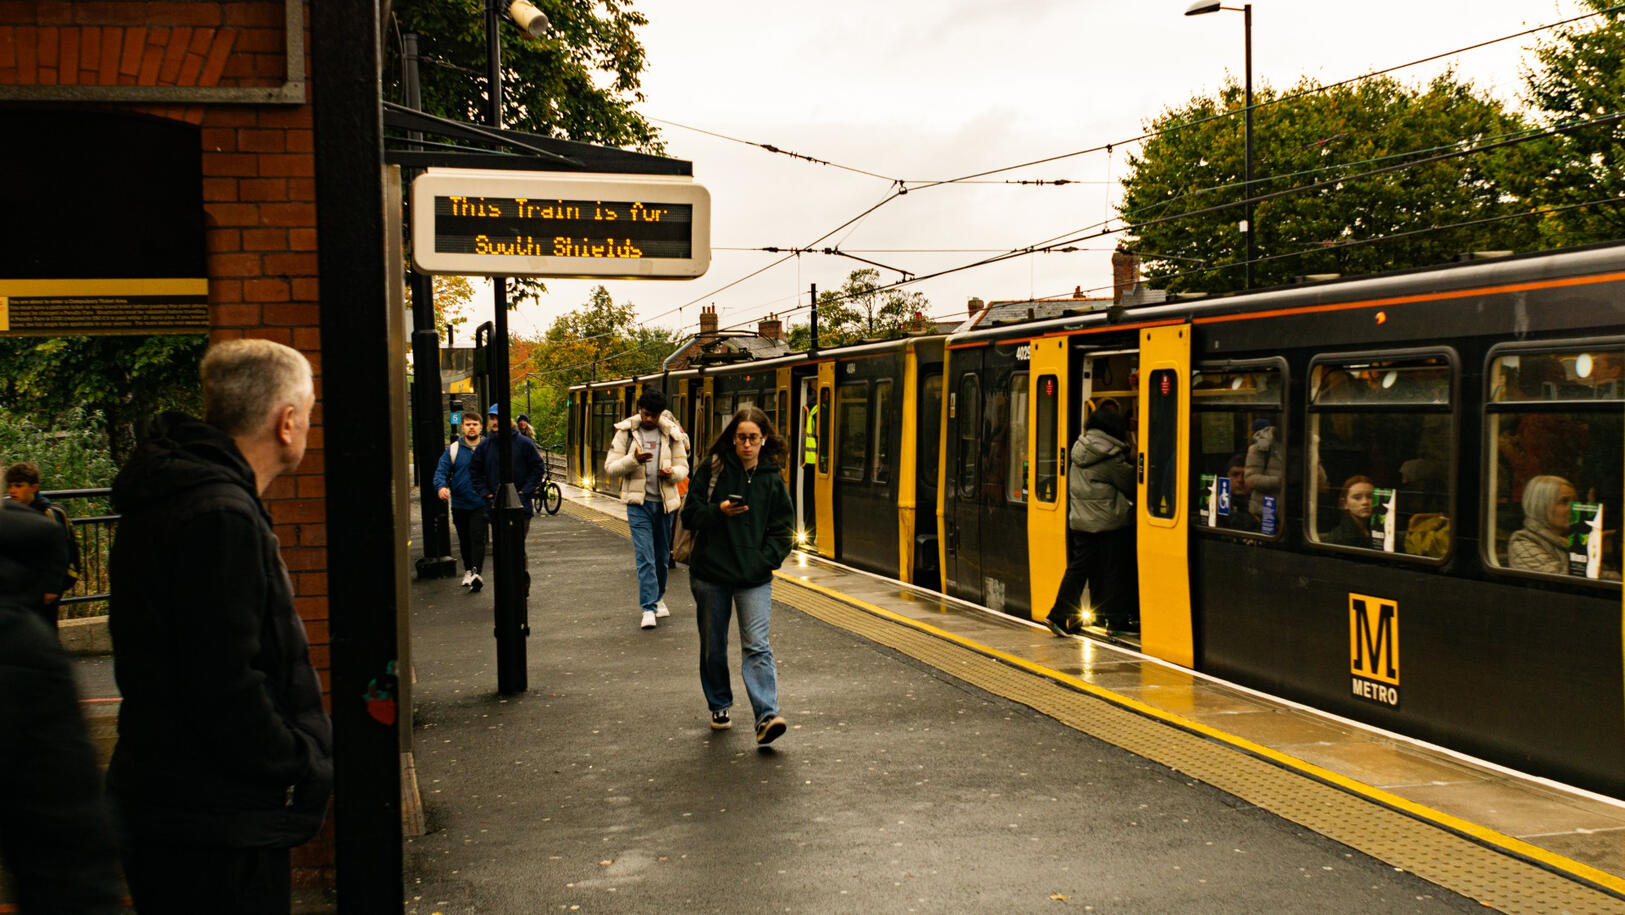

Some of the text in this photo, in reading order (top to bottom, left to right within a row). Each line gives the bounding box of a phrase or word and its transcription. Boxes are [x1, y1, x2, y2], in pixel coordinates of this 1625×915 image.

[449, 196, 502, 217] This
[515, 198, 580, 220] Train
[594, 200, 618, 221] is
[475, 235, 642, 258] South Shields
[1352, 598, 1396, 680] M
[1351, 678, 1399, 706] METRO
